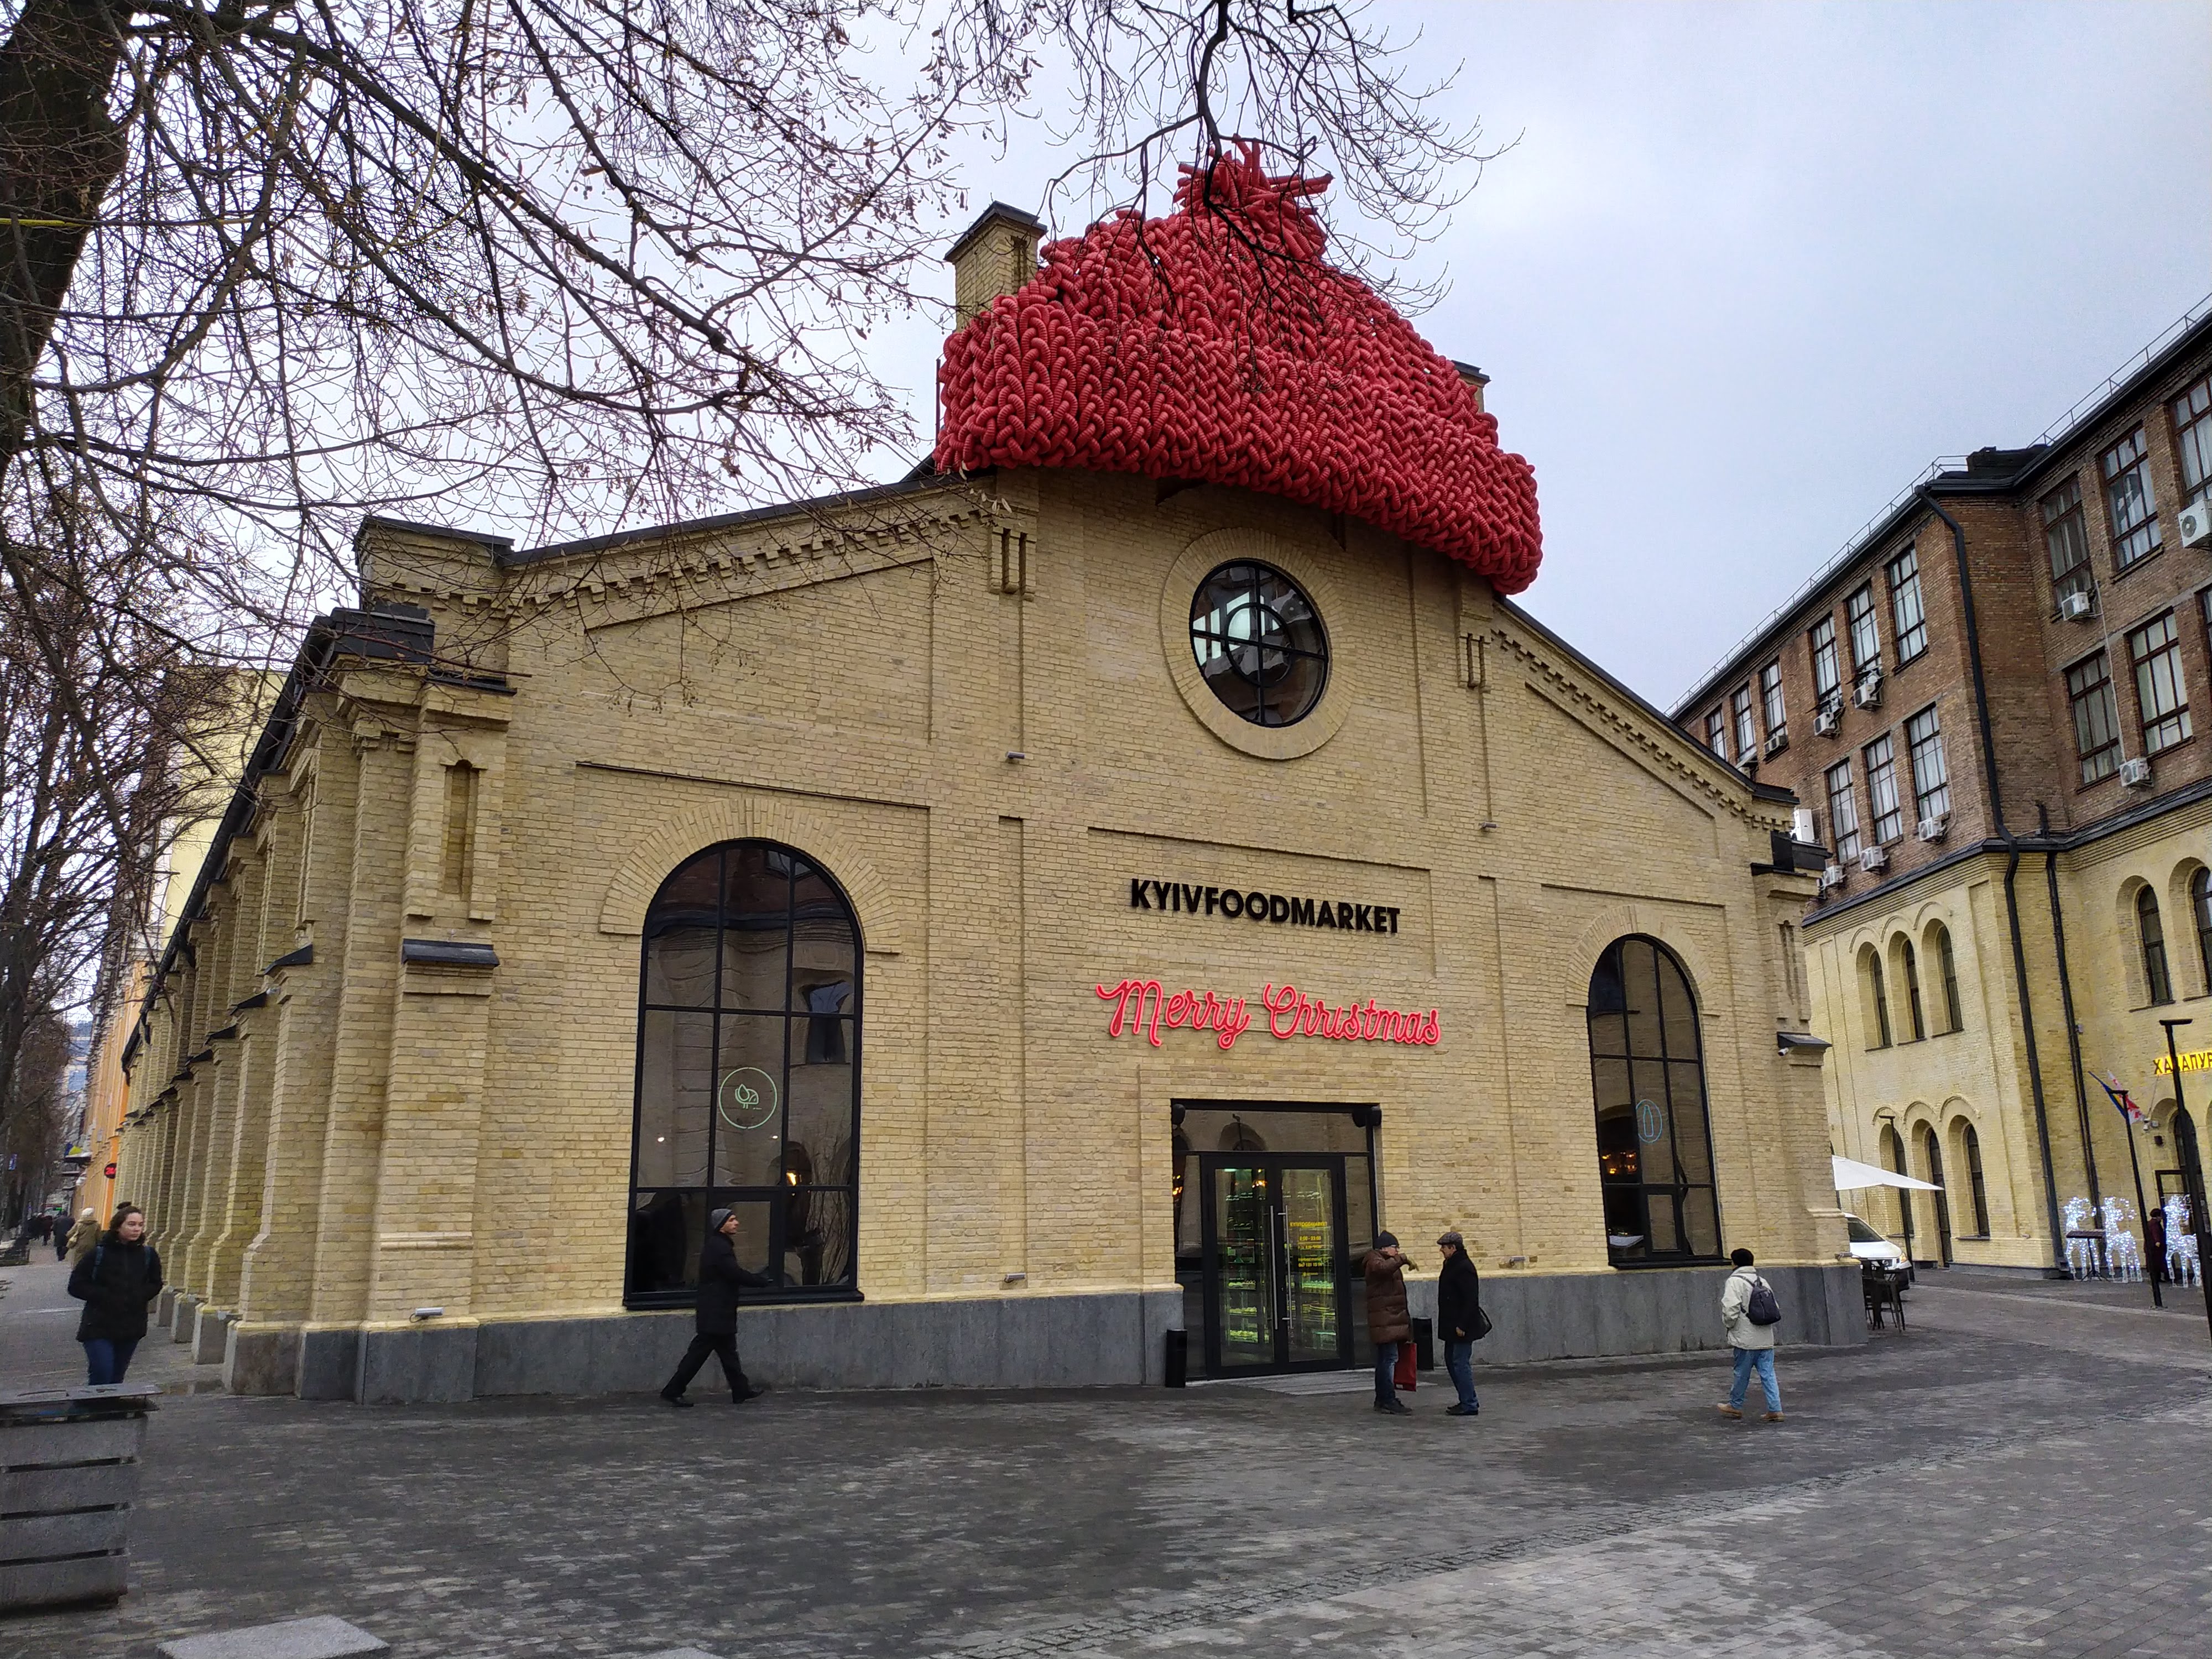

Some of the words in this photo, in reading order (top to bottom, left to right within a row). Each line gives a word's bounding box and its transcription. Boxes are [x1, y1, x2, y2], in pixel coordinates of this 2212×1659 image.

[1131, 878, 1400, 933] KYIVFOODMARKET
[1097, 979, 1251, 1049] Merry
[1263, 983, 1441, 1045] Christmas
[2153, 1052, 2212, 1074] ХААПУР
